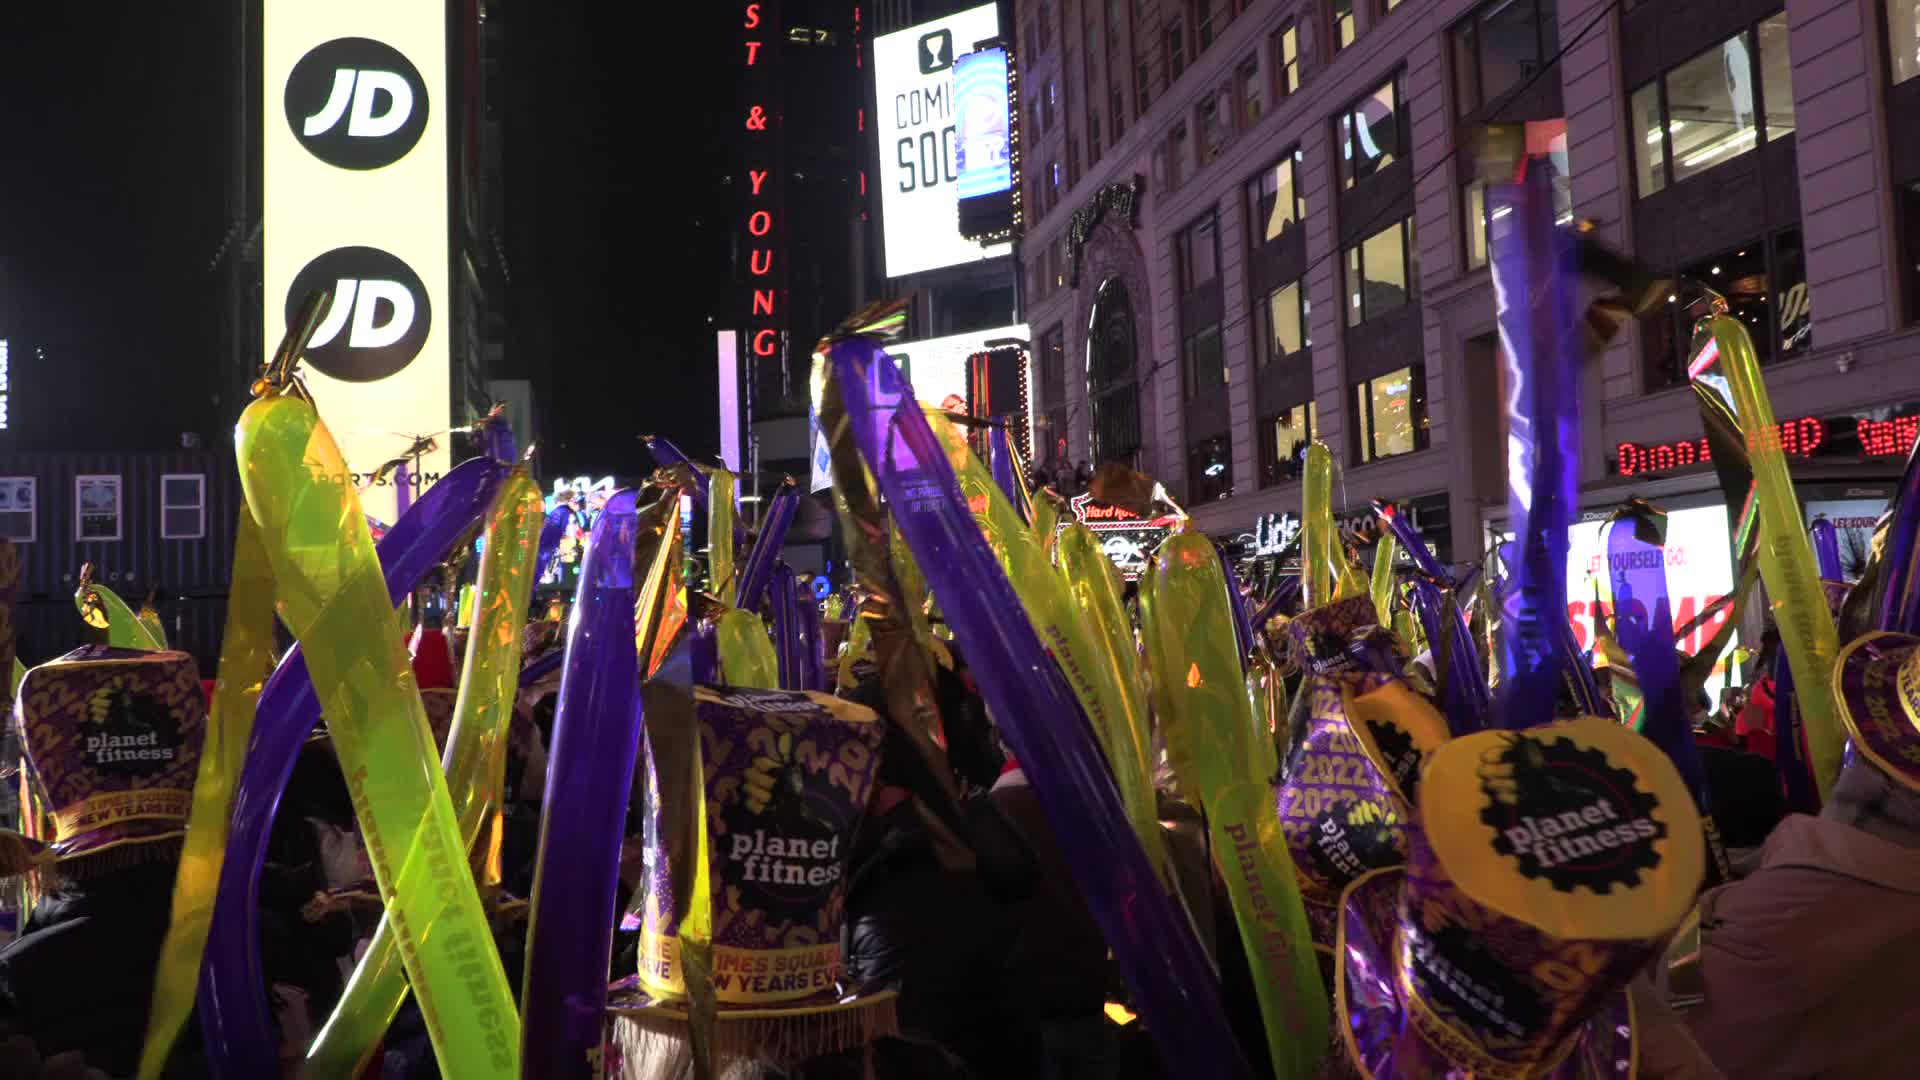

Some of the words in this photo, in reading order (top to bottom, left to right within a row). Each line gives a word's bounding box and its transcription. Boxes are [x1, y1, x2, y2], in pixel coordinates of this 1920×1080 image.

[303, 68, 414, 137] JD
[745, 105, 767, 131] &
[896, 81, 951, 129] COMI
[897, 125, 957, 193] SOO
[749, 170, 775, 356] YOUNG
[304, 278, 416, 350] JD
[319, 471, 441, 488] PORTS.COM
[1086, 504, 1114, 519] Hard
[1608, 550, 1664, 571] YOURSELF
[87, 731, 157, 753] planet
[96, 747, 173, 764] fitness
[1300, 755, 1370, 787] 2022
[1503, 797, 1619, 854] planet
[729, 831, 839, 859] planet
[1319, 817, 1362, 868] plan
[1531, 817, 1657, 868] fitness
[1224, 822, 1278, 924] planet
[716, 954, 769, 974] IMES
[773, 951, 841, 974] SQUAR
[737, 974, 809, 992] YEARS
